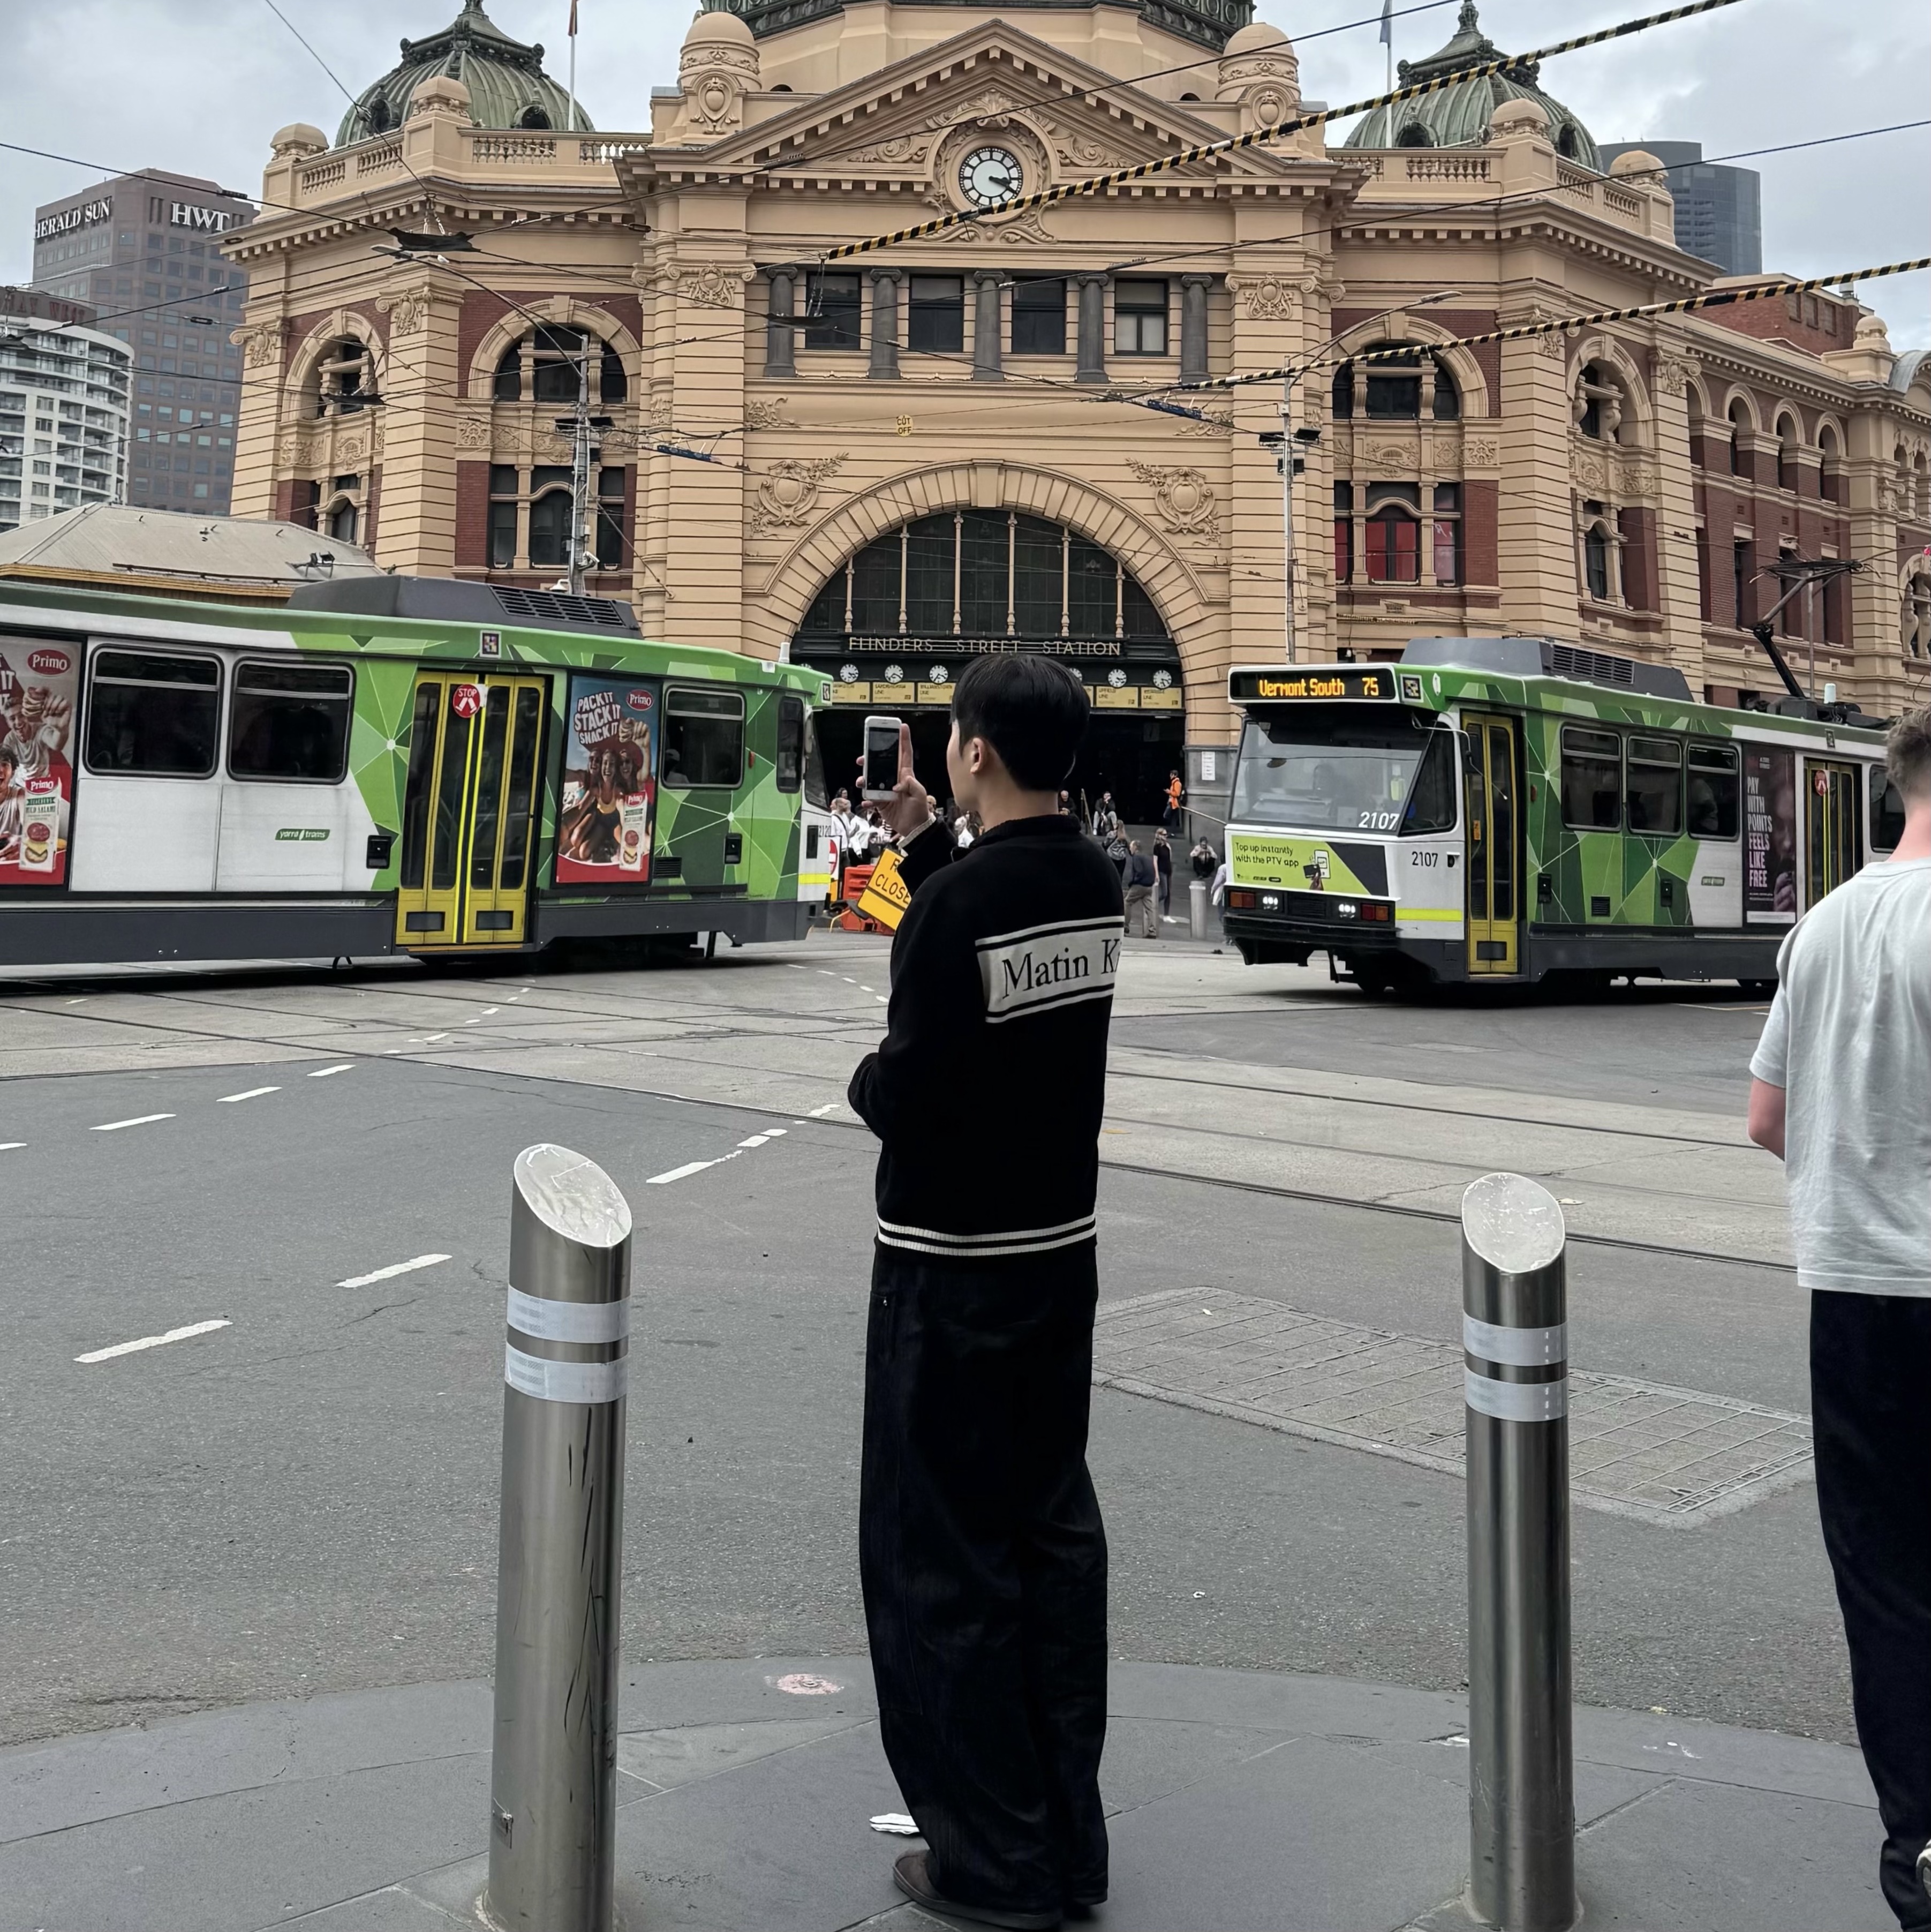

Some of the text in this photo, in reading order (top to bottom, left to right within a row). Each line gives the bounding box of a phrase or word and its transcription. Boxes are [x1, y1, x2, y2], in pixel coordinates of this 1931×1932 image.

[35, 199, 111, 238] HERALD SUN
[171, 202, 230, 231] HWT
[898, 426, 911, 434] OFF
[849, 637, 1121, 656] FLINDERS STREET STATION
[32, 654, 67, 671] Primo
[1, 670, 16, 690] IT
[1259, 677, 1379, 696] Vermont South 75
[458, 688, 477, 697] STOP
[578, 691, 613, 712] PACK IT
[629, 694, 652, 706] Primo
[574, 704, 621, 732] STACK IT
[579, 722, 618, 745] SNACK IT
[31, 780, 54, 791] Primo
[1747, 776, 1759, 794] PAY
[1747, 795, 1765, 813] WITH
[1358, 811, 1400, 830] 2107
[1747, 813, 1772, 832] POINTS
[1235, 842, 1293, 856] Top up instantly
[1748, 832, 1770, 851] FEELS
[1235, 854, 1299, 868] with the PTV app
[1412, 851, 1438, 867] 2107
[1749, 851, 1766, 869] LIKE
[1749, 870, 1768, 888] FREE
[875, 874, 909, 905] CLOSE
[1002, 938, 1122, 999] Matin K
